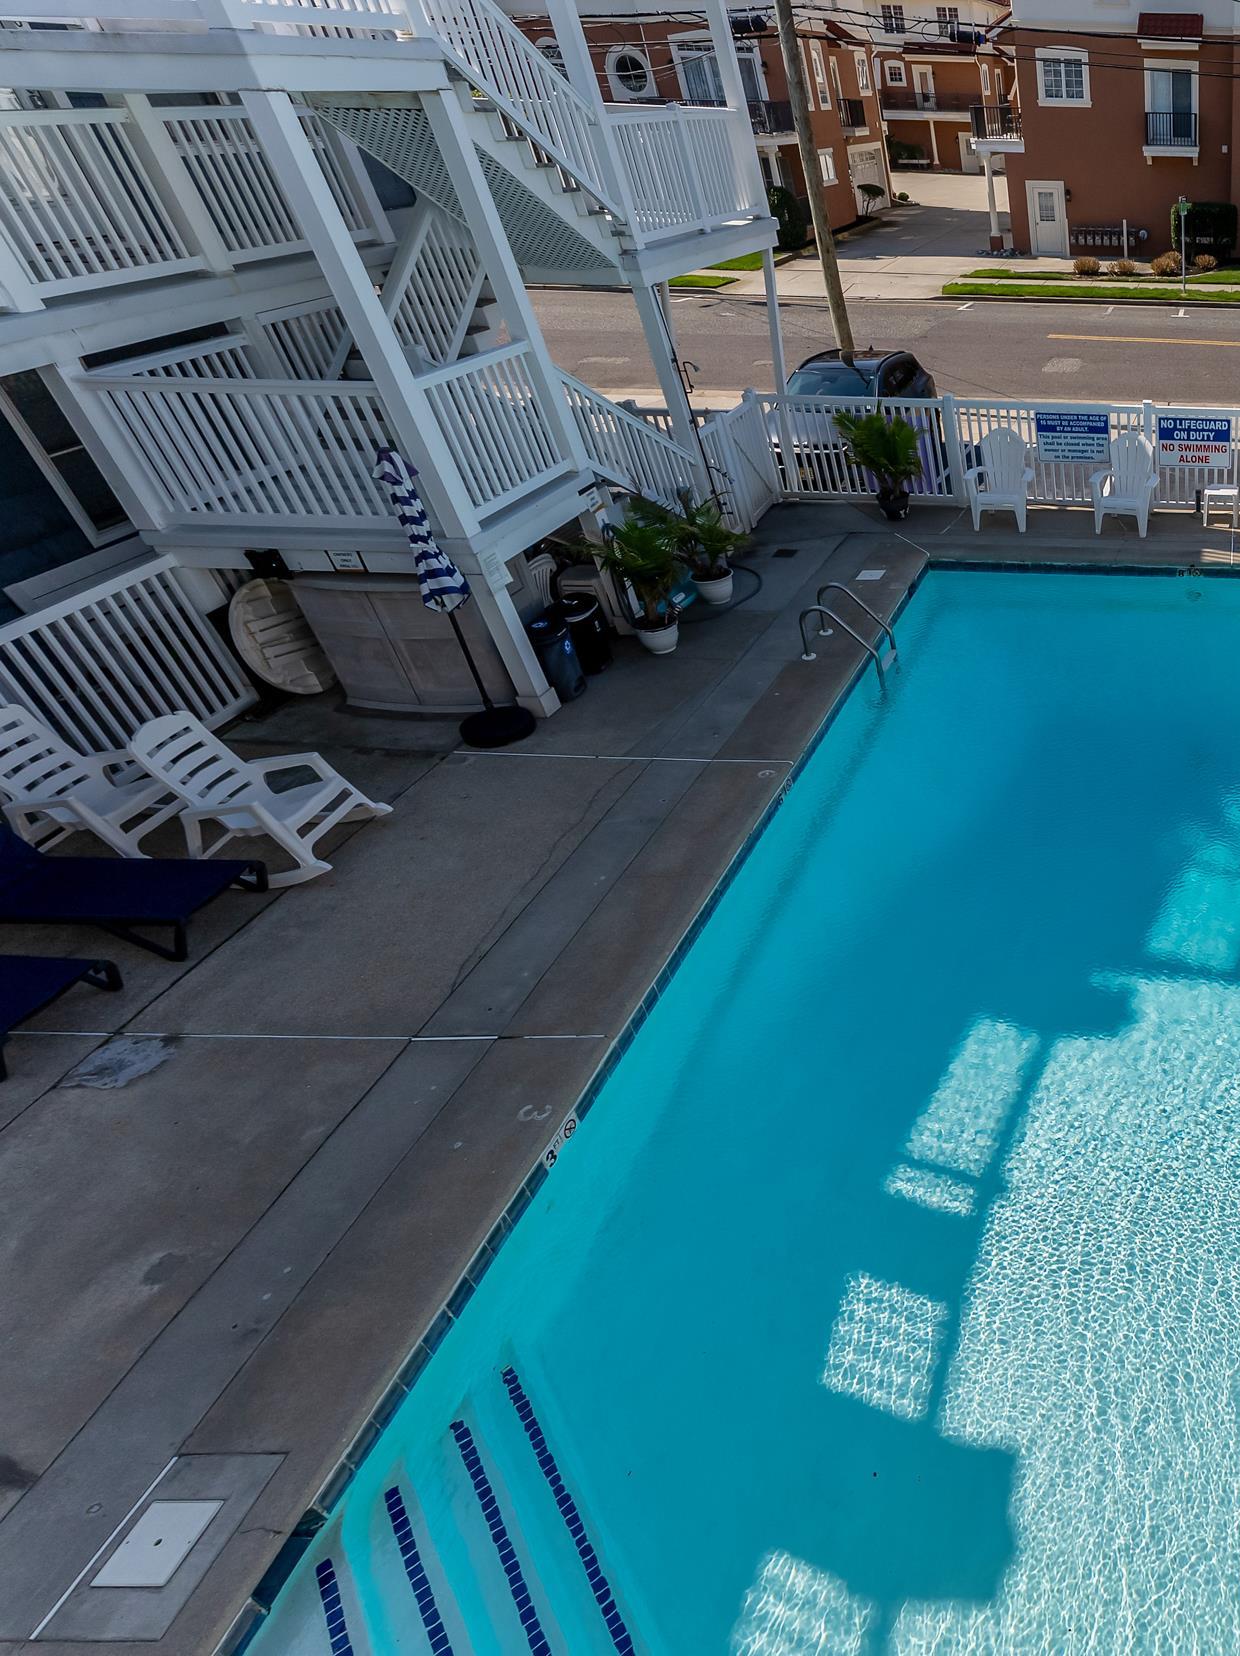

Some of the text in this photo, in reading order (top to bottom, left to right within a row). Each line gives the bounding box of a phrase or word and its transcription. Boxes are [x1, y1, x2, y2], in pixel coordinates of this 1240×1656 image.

[1160, 419, 1229, 430] NO LIFEGUARD
[1173, 431, 1215, 440] ON DUTY
[1161, 443, 1228, 453] NO SWIMMING
[1179, 454, 1210, 464] ALONE
[546, 1149, 558, 1168] 3
